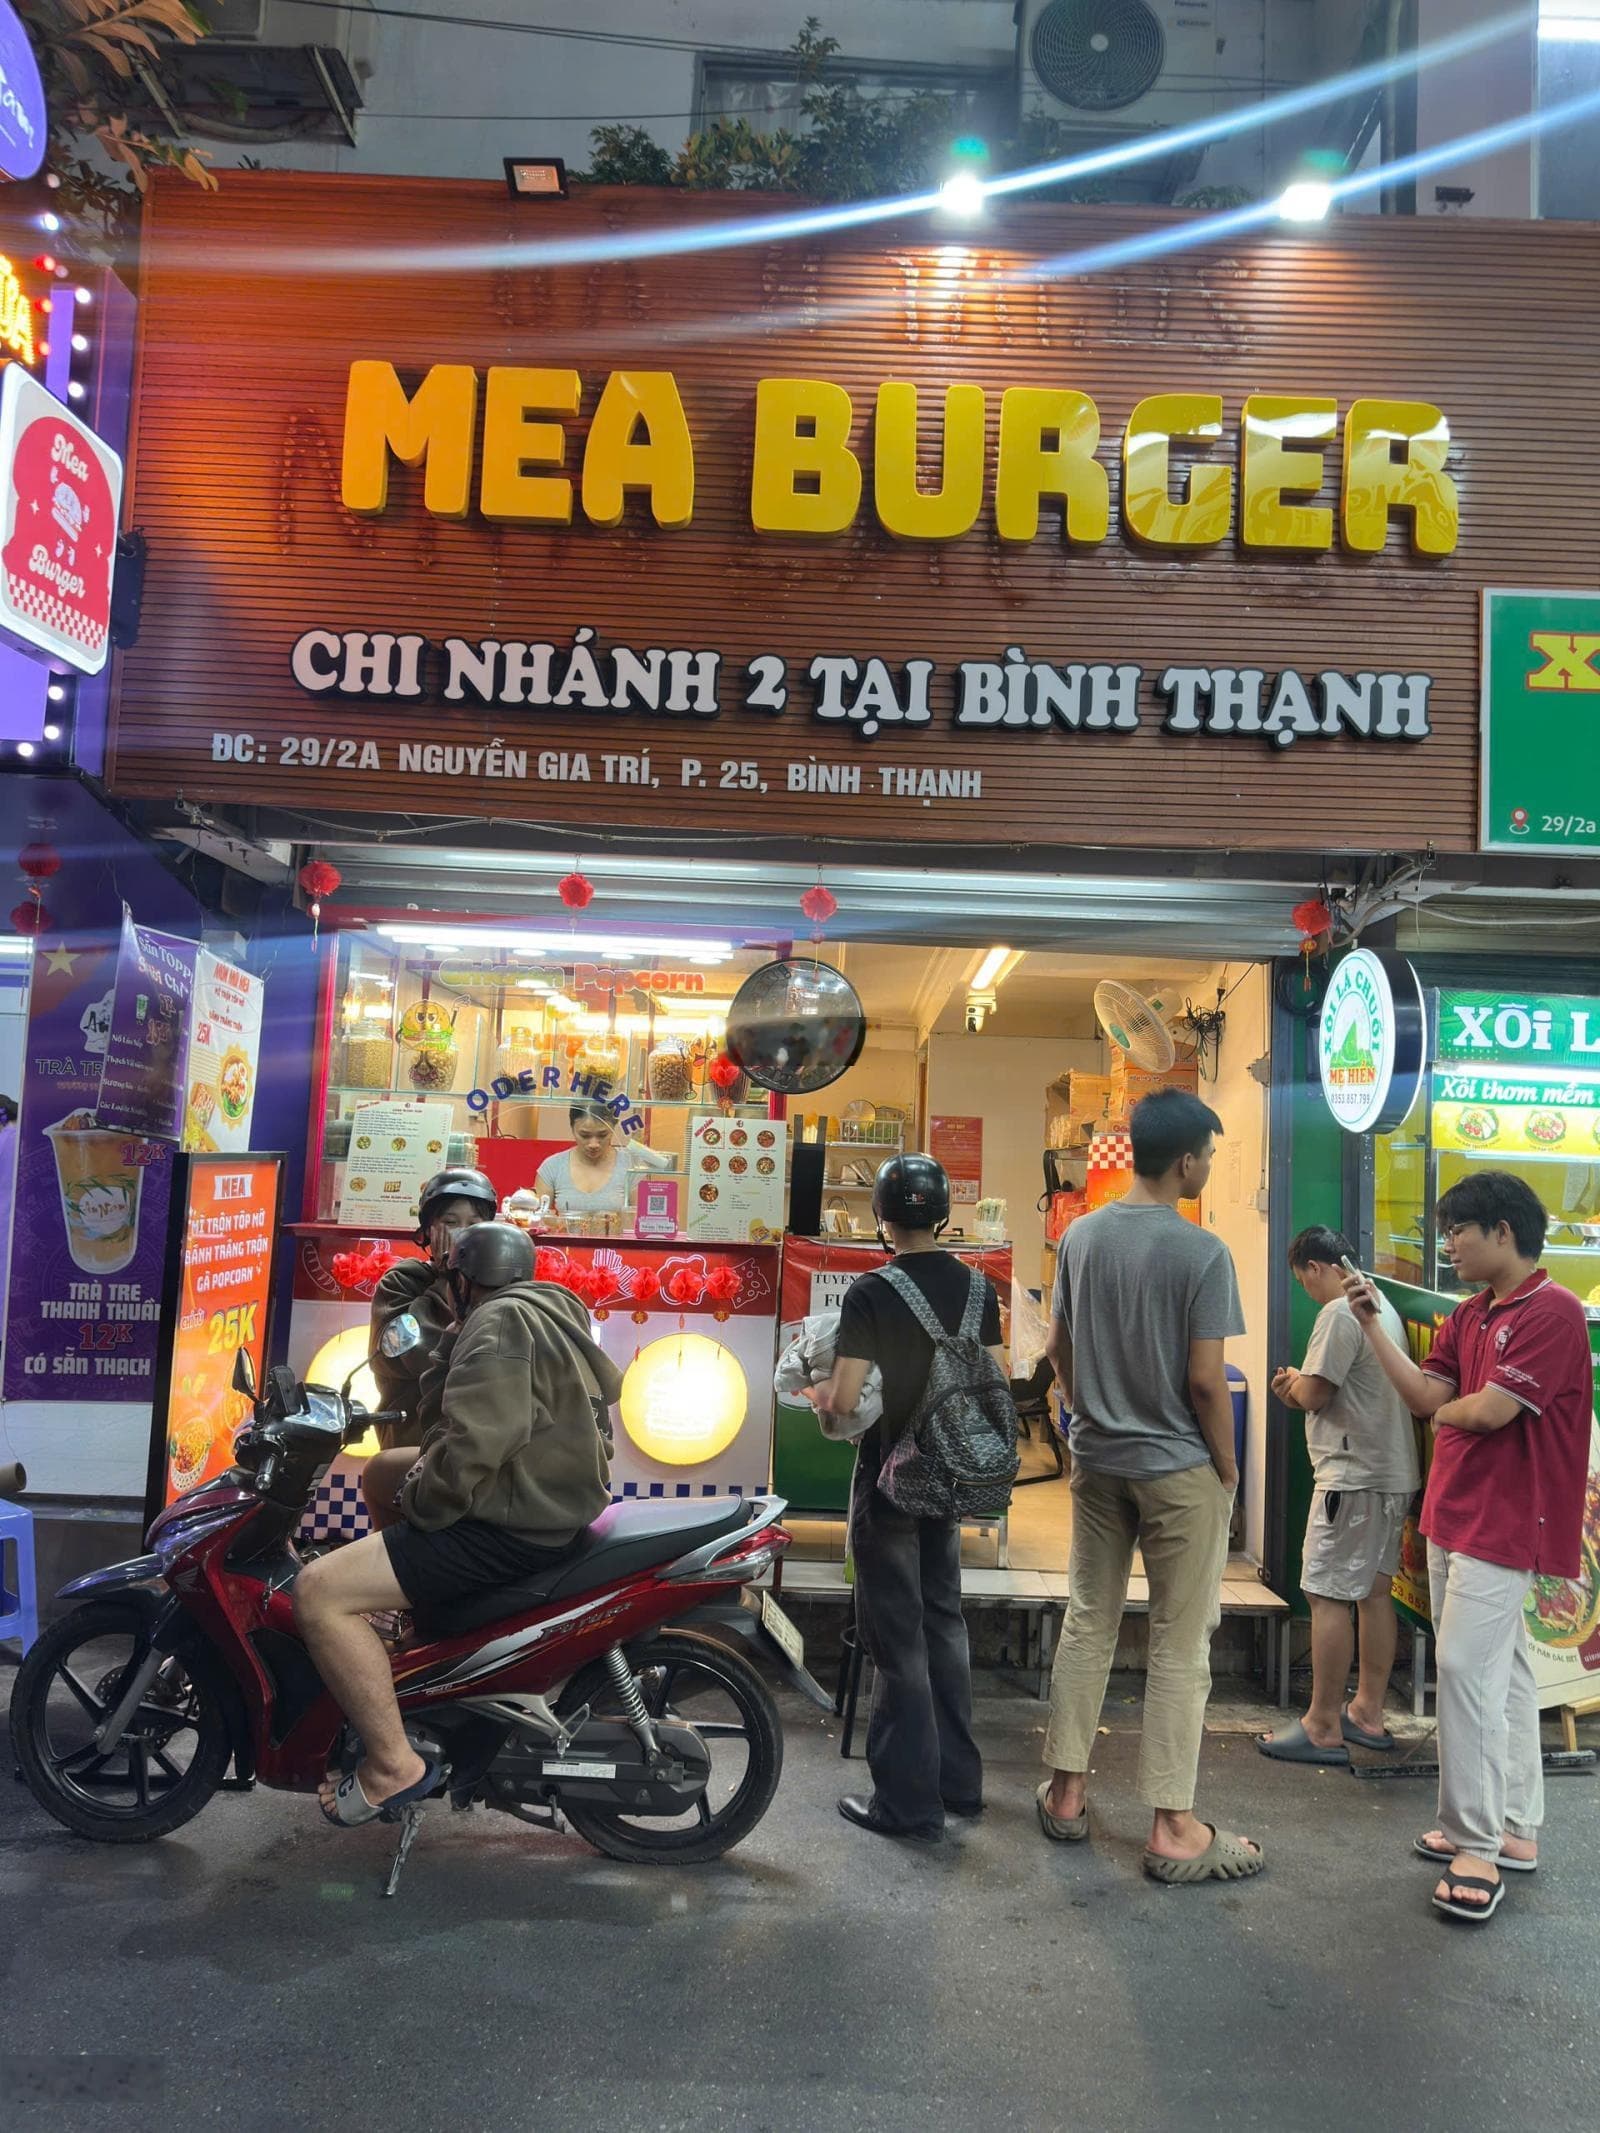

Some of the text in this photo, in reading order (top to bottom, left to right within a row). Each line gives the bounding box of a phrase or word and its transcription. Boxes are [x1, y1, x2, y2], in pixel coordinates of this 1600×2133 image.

[51, 433, 89, 482] Mea
[341, 359, 1460, 557] MEA BURGER
[29, 544, 86, 599] Burger
[290, 626, 1433, 749] CHI NHÁNH 2 TẠI BÌNH THẠNH
[211, 733, 982, 806] ĐC: 29/2A NGUYỄN GIA TRÍ, P. 25, BÌNH THẠNH
[1541, 814, 1597, 836] 29/2a
[574, 963, 705, 997] Popcorn
[35, 1055, 77, 1075] TRÀ
[1329, 1068, 1344, 1088] MẸ
[466, 1066, 644, 1136] ODER HERE
[1481, 1080, 1538, 1102] thơm
[1541, 1081, 1597, 1105] mềm
[120, 1142, 167, 1167] 12K
[221, 1176, 246, 1198] MEA
[185, 1241, 212, 1265] BÁNH
[246, 1234, 268, 1258] TRỘN
[68, 1279, 142, 1302] TRÀ TRE
[196, 1266, 253, 1292] GÀ POPCORN
[40, 1301, 100, 1320] THANH
[79, 1323, 134, 1351] 12K
[208, 1301, 259, 1355] 25K
[24, 1346, 152, 1381] CÓ SẴN THẠCH
